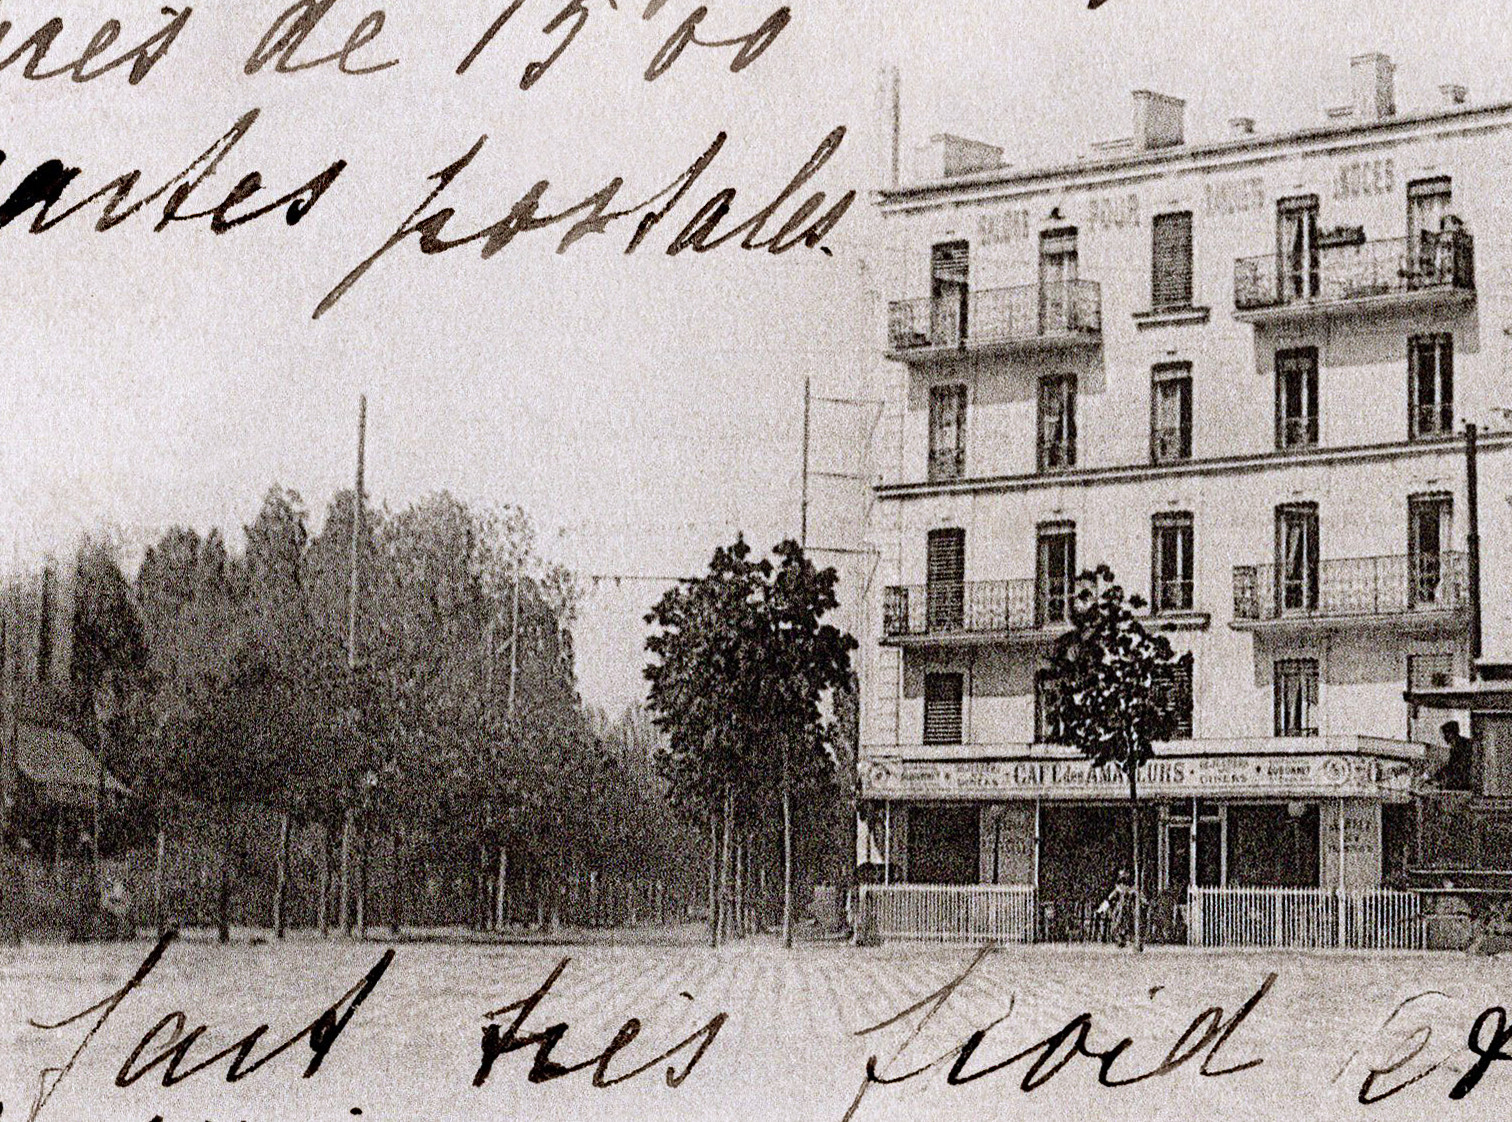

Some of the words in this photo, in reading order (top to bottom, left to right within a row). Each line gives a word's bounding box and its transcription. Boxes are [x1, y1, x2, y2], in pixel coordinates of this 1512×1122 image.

[0, 108, 347, 235] artes
[1086, 762, 1186, 784] AMAEURS
[843, 942, 1278, 1122] froid
